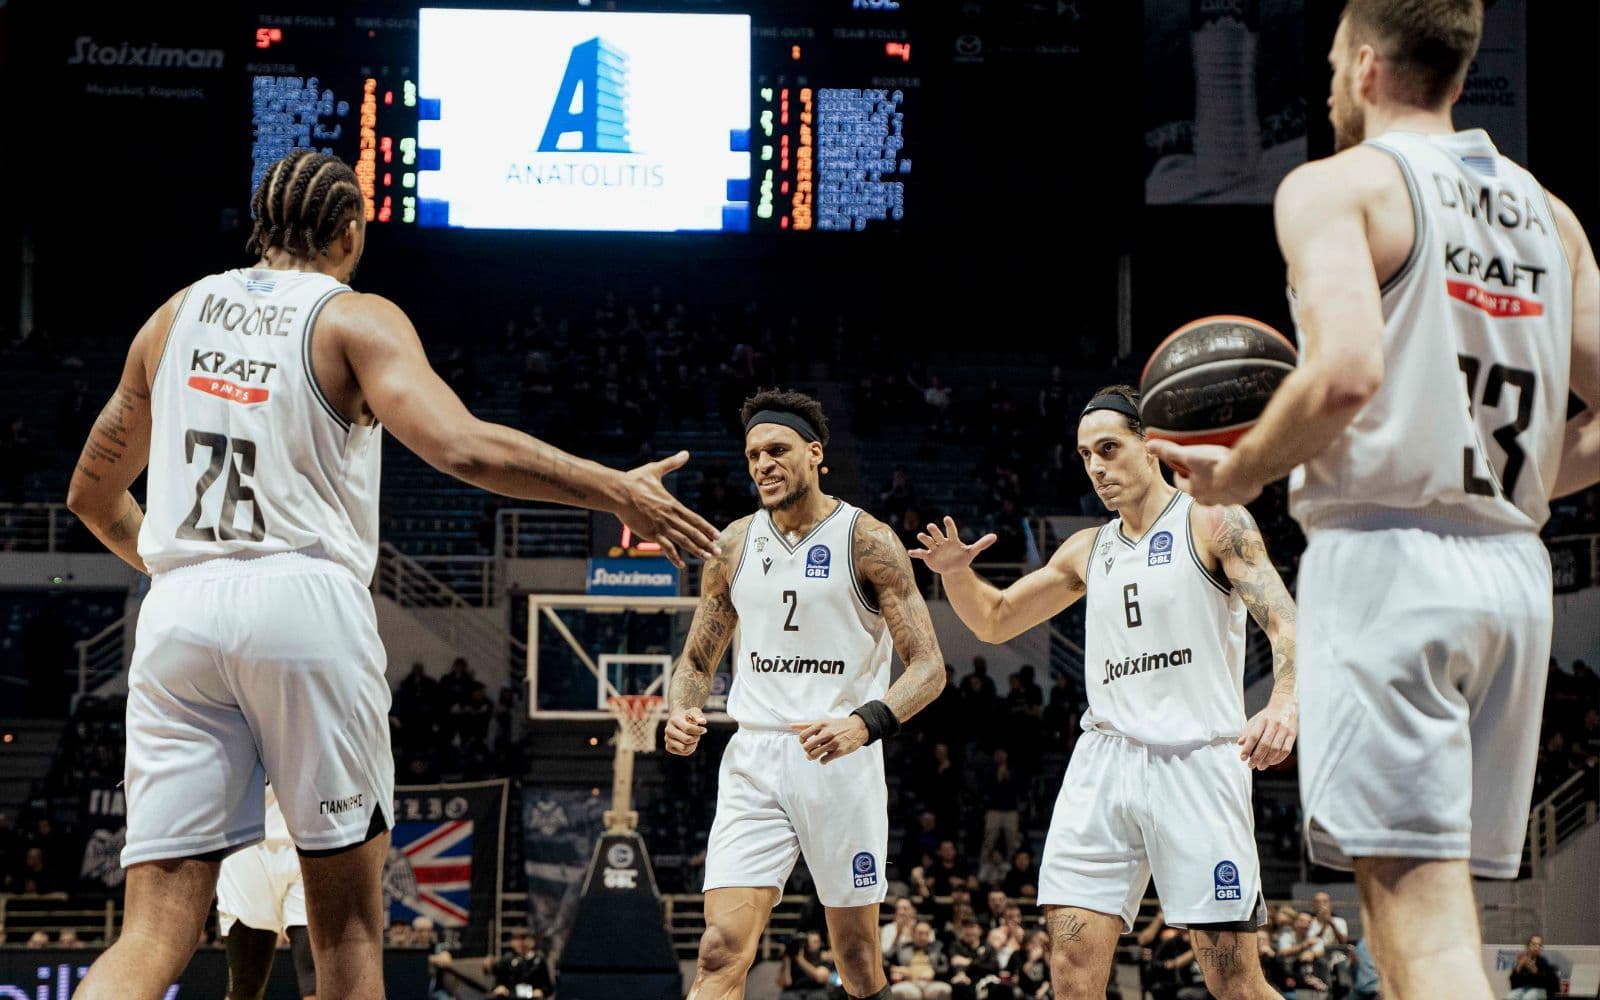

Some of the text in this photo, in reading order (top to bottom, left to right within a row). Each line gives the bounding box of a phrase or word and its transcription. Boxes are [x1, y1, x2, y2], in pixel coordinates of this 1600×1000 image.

[67, 36, 225, 68] Stoiximan
[505, 163, 665, 188] ANATOLITIS
[1444, 242, 1547, 294] KRAFT
[198, 293, 297, 337] MOORE
[190, 348, 277, 383] KRAFT
[175, 428, 266, 542] 26
[591, 567, 673, 586] Stoiximan
[807, 568, 828, 578] GBL
[1149, 555, 1170, 565] GBL
[782, 590, 799, 632] 2
[1123, 582, 1142, 629] 6
[1102, 648, 1193, 685] Stoiximan
[855, 876, 876, 887] GBL
[1216, 889, 1240, 900] GBL
